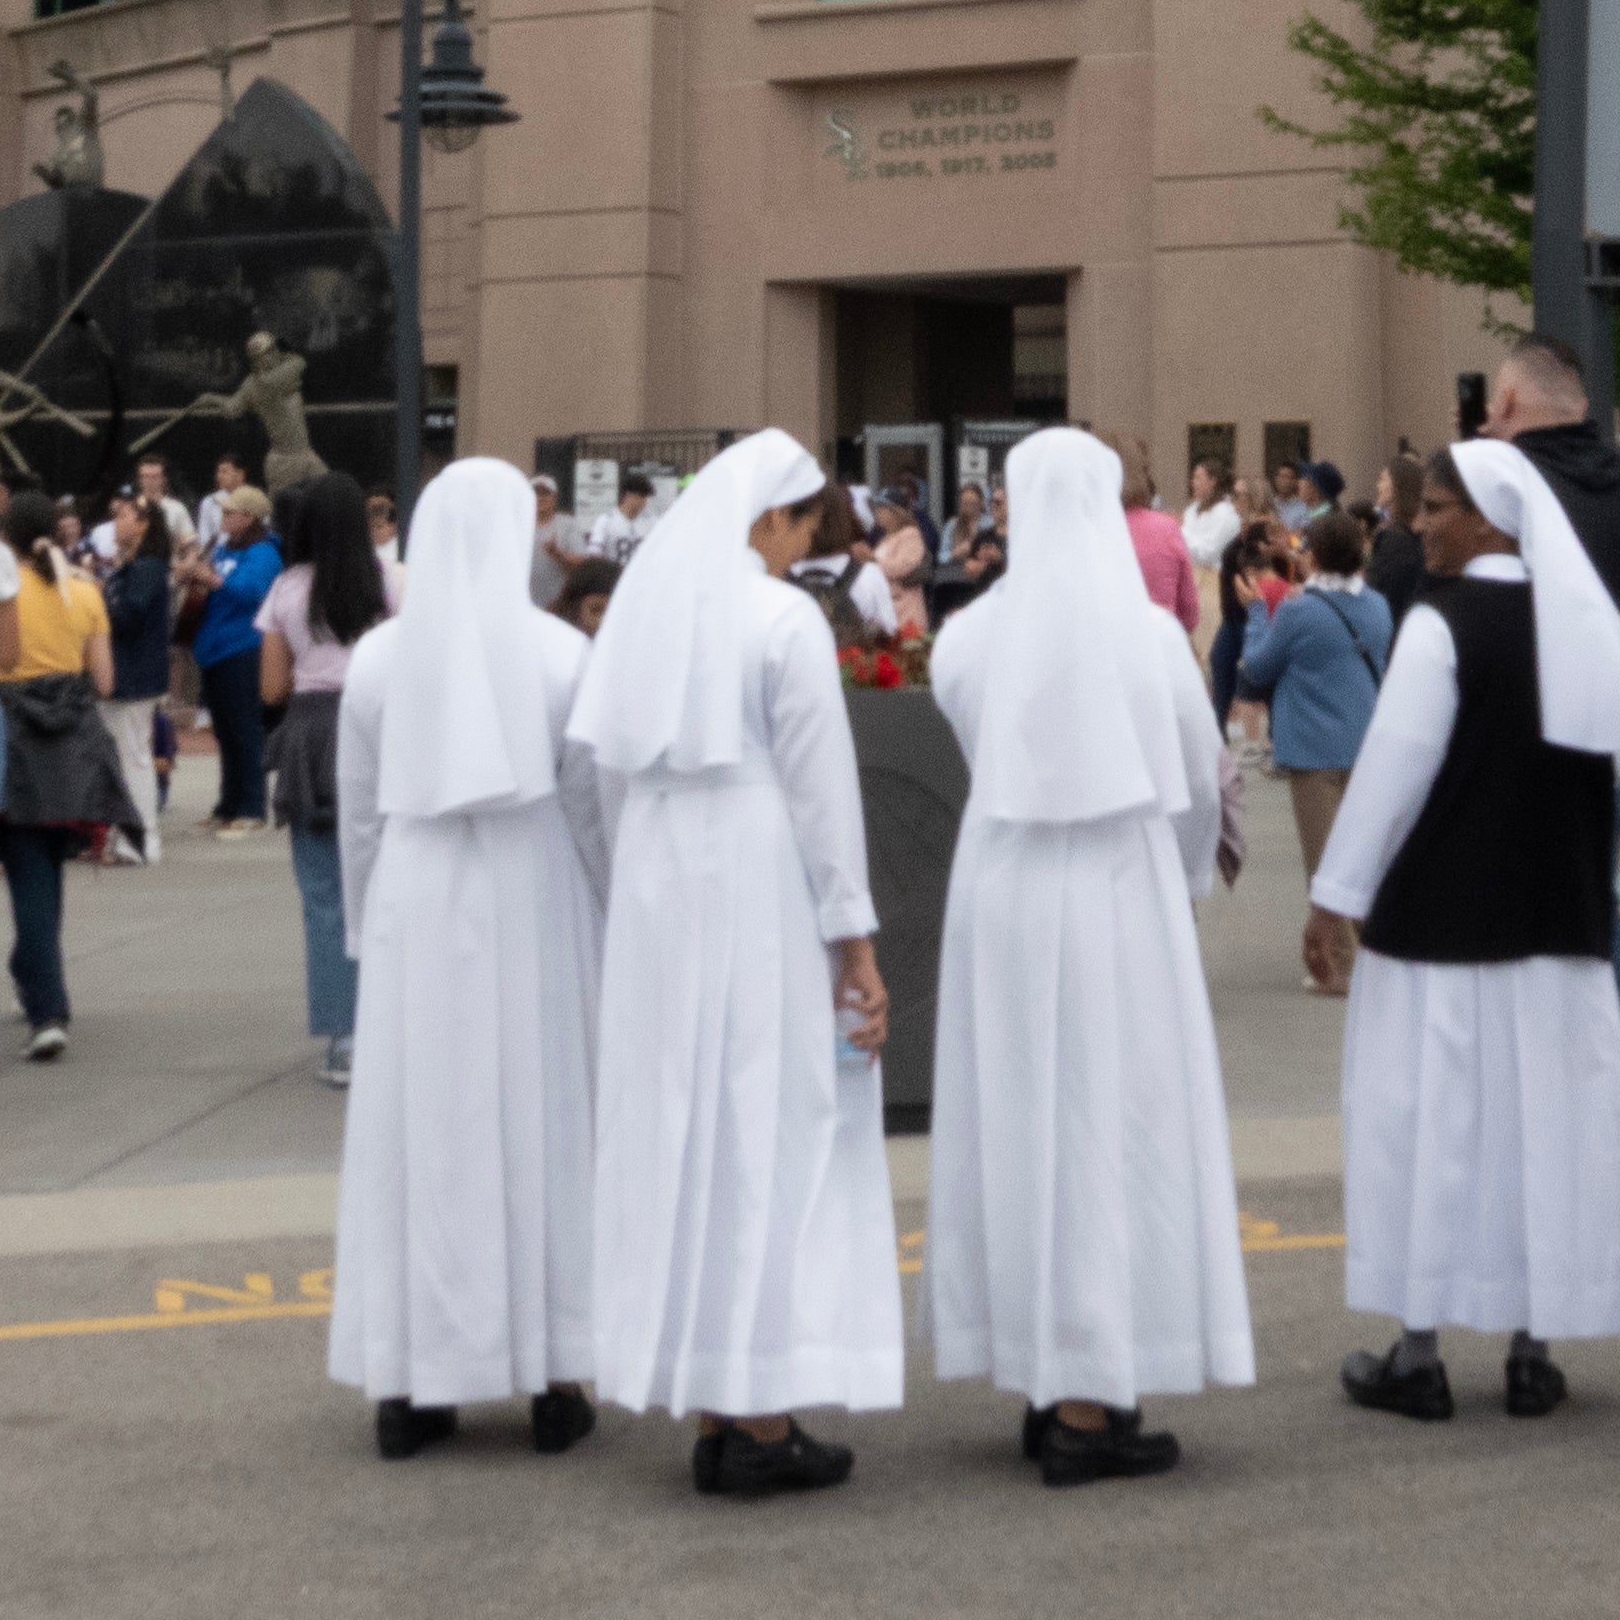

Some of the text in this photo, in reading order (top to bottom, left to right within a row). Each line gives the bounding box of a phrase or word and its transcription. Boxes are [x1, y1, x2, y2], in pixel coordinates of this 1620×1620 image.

[911, 94, 1021, 119] WORLD
[877, 120, 1056, 150] CHAMPIONS
[1000, 151, 1058, 171] 2005
